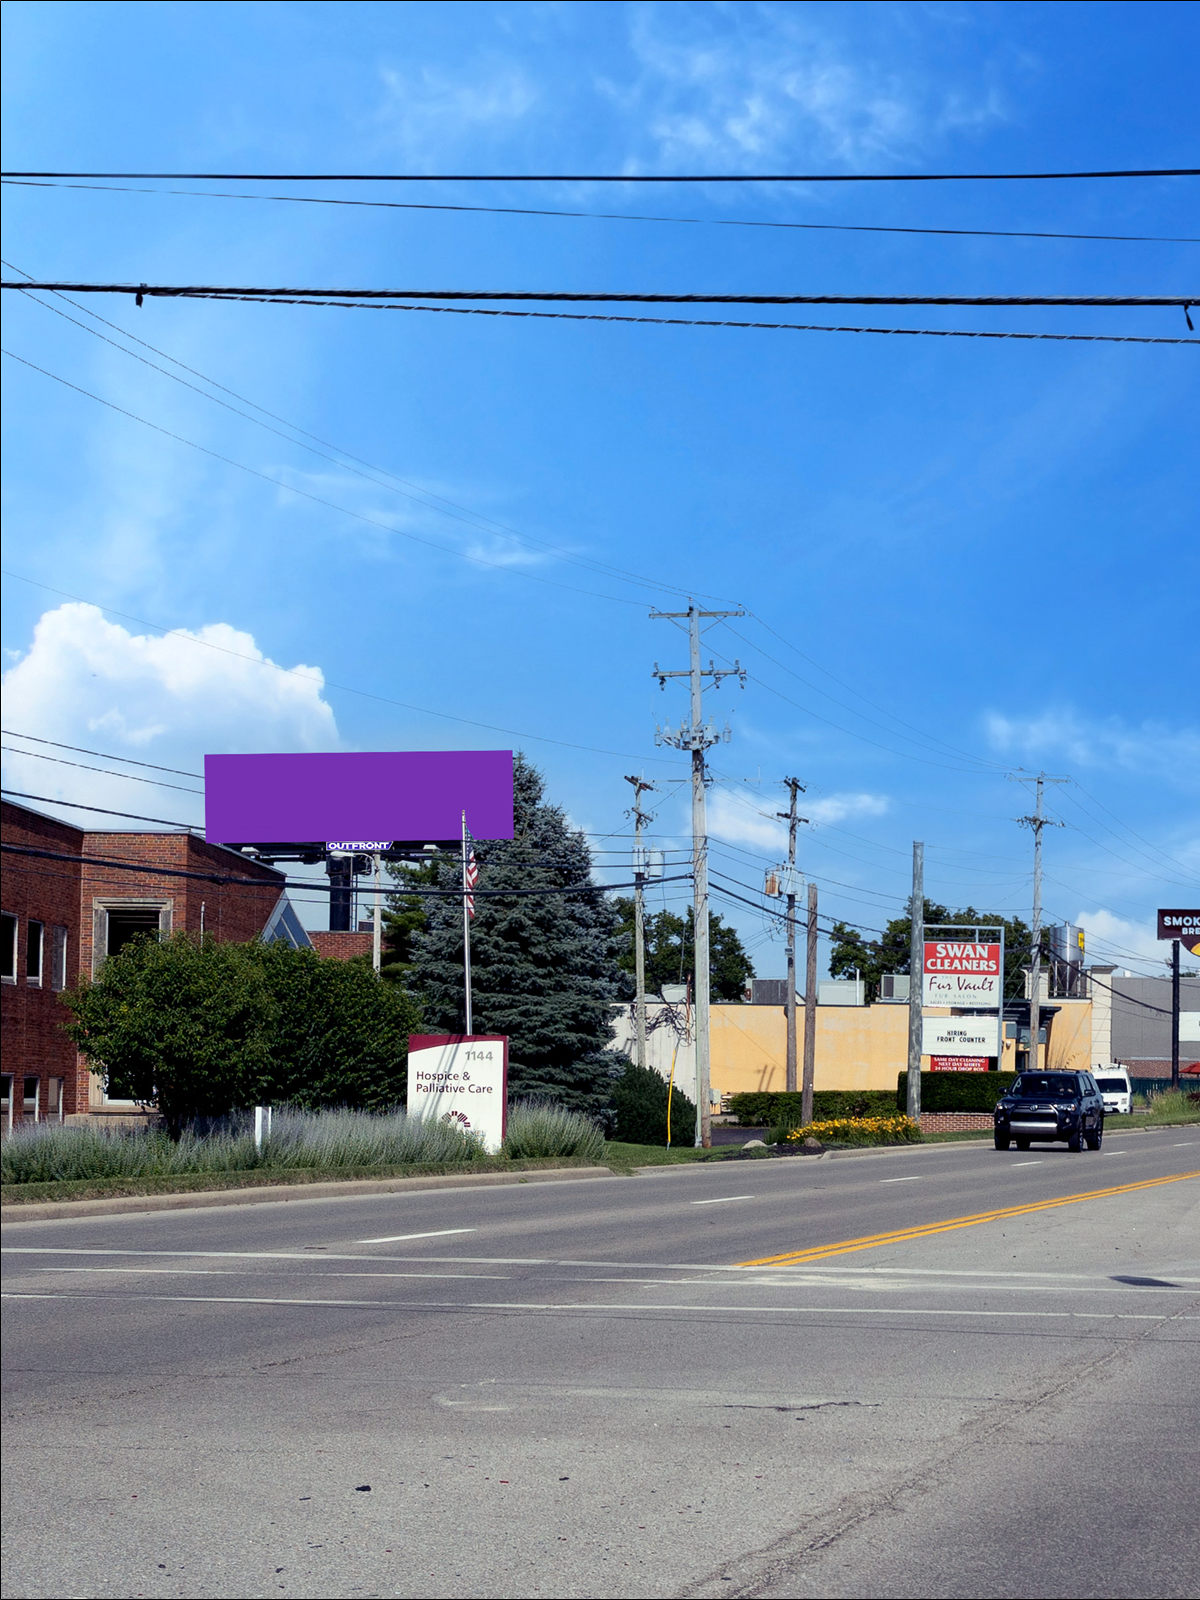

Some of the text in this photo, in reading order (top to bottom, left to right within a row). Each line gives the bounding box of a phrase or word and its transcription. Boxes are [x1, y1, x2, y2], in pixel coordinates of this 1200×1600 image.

[328, 842, 389, 850] OUTFRONT
[936, 944, 989, 958] SWAN
[926, 958, 997, 972] CLEANERS
[929, 975, 994, 992] Fur Vault
[465, 1051, 493, 1061] 1144
[416, 1071, 471, 1082] Hospice &
[416, 1083, 493, 1093] Palliative Care
